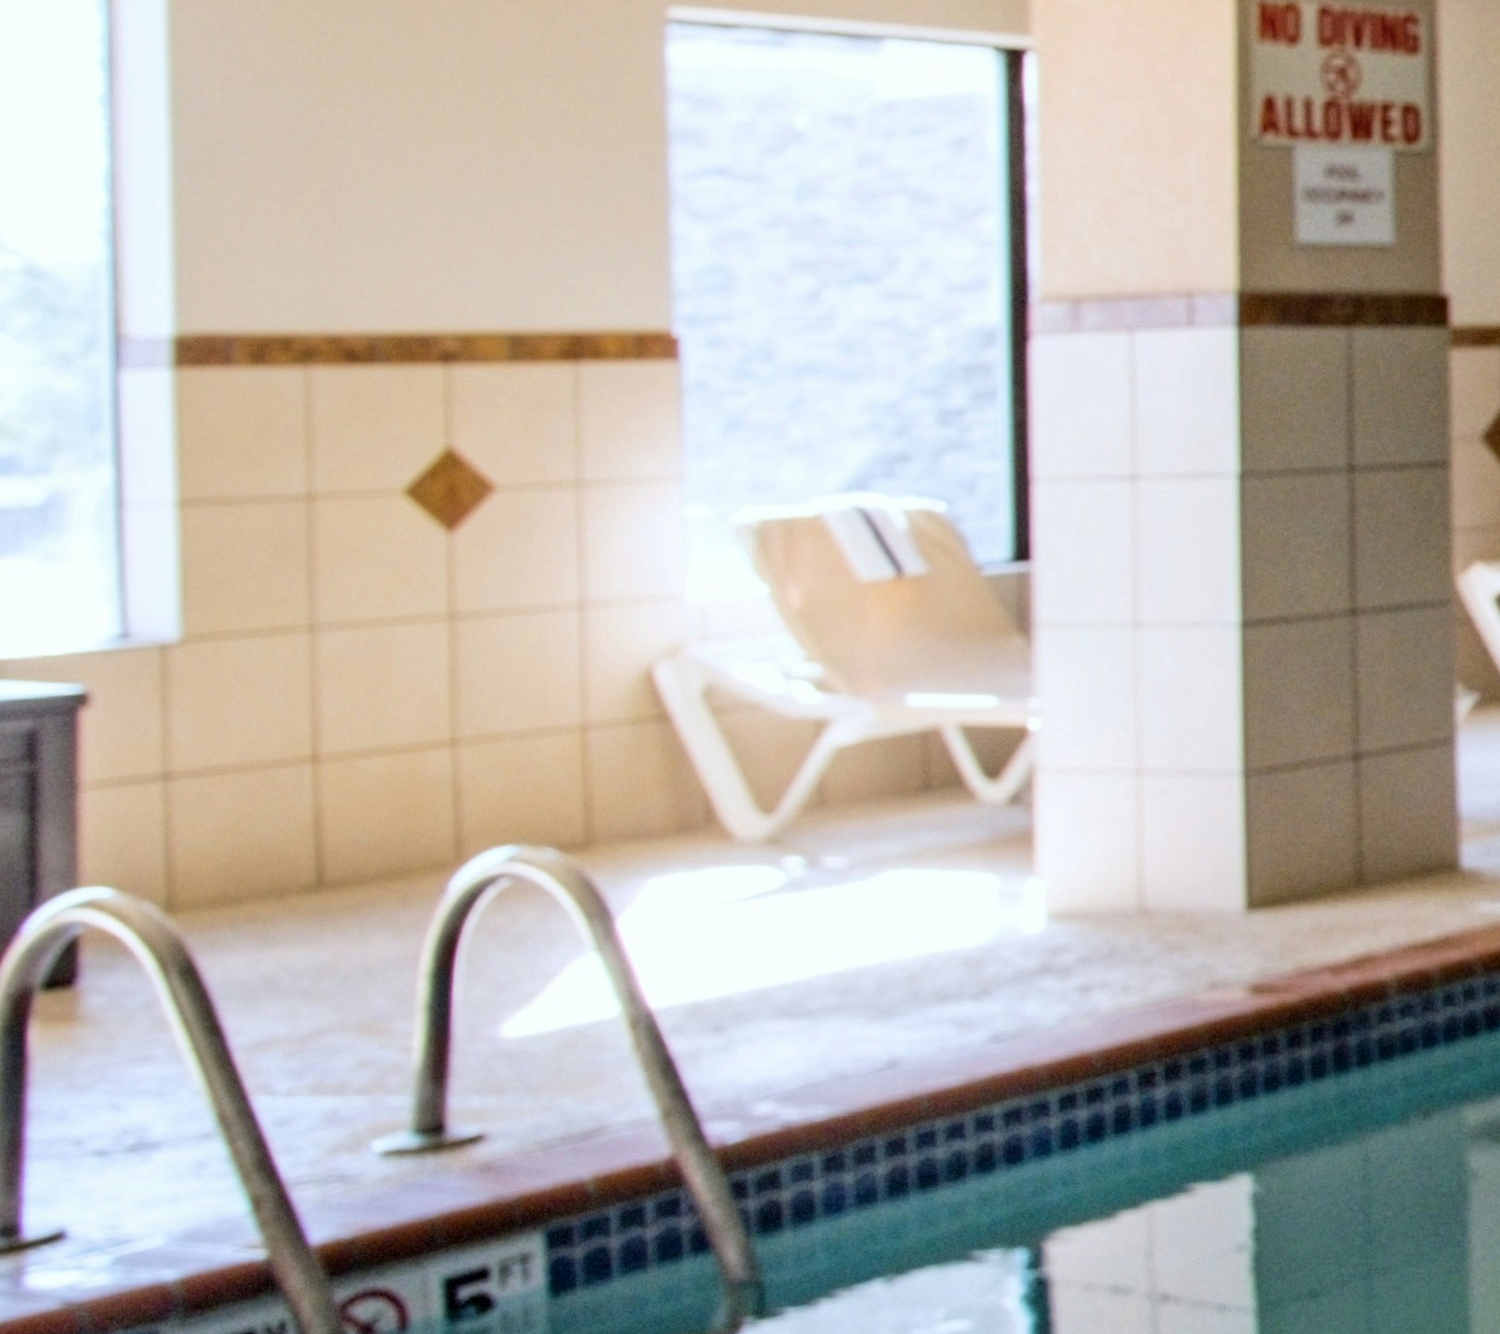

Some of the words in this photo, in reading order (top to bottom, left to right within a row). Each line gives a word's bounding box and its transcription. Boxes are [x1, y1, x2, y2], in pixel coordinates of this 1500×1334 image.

[1258, 1, 1300, 46] NO
[1317, 4, 1420, 55] DIVING
[1260, 94, 1421, 145] ALLOWED
[443, 1267, 495, 1325] 5
